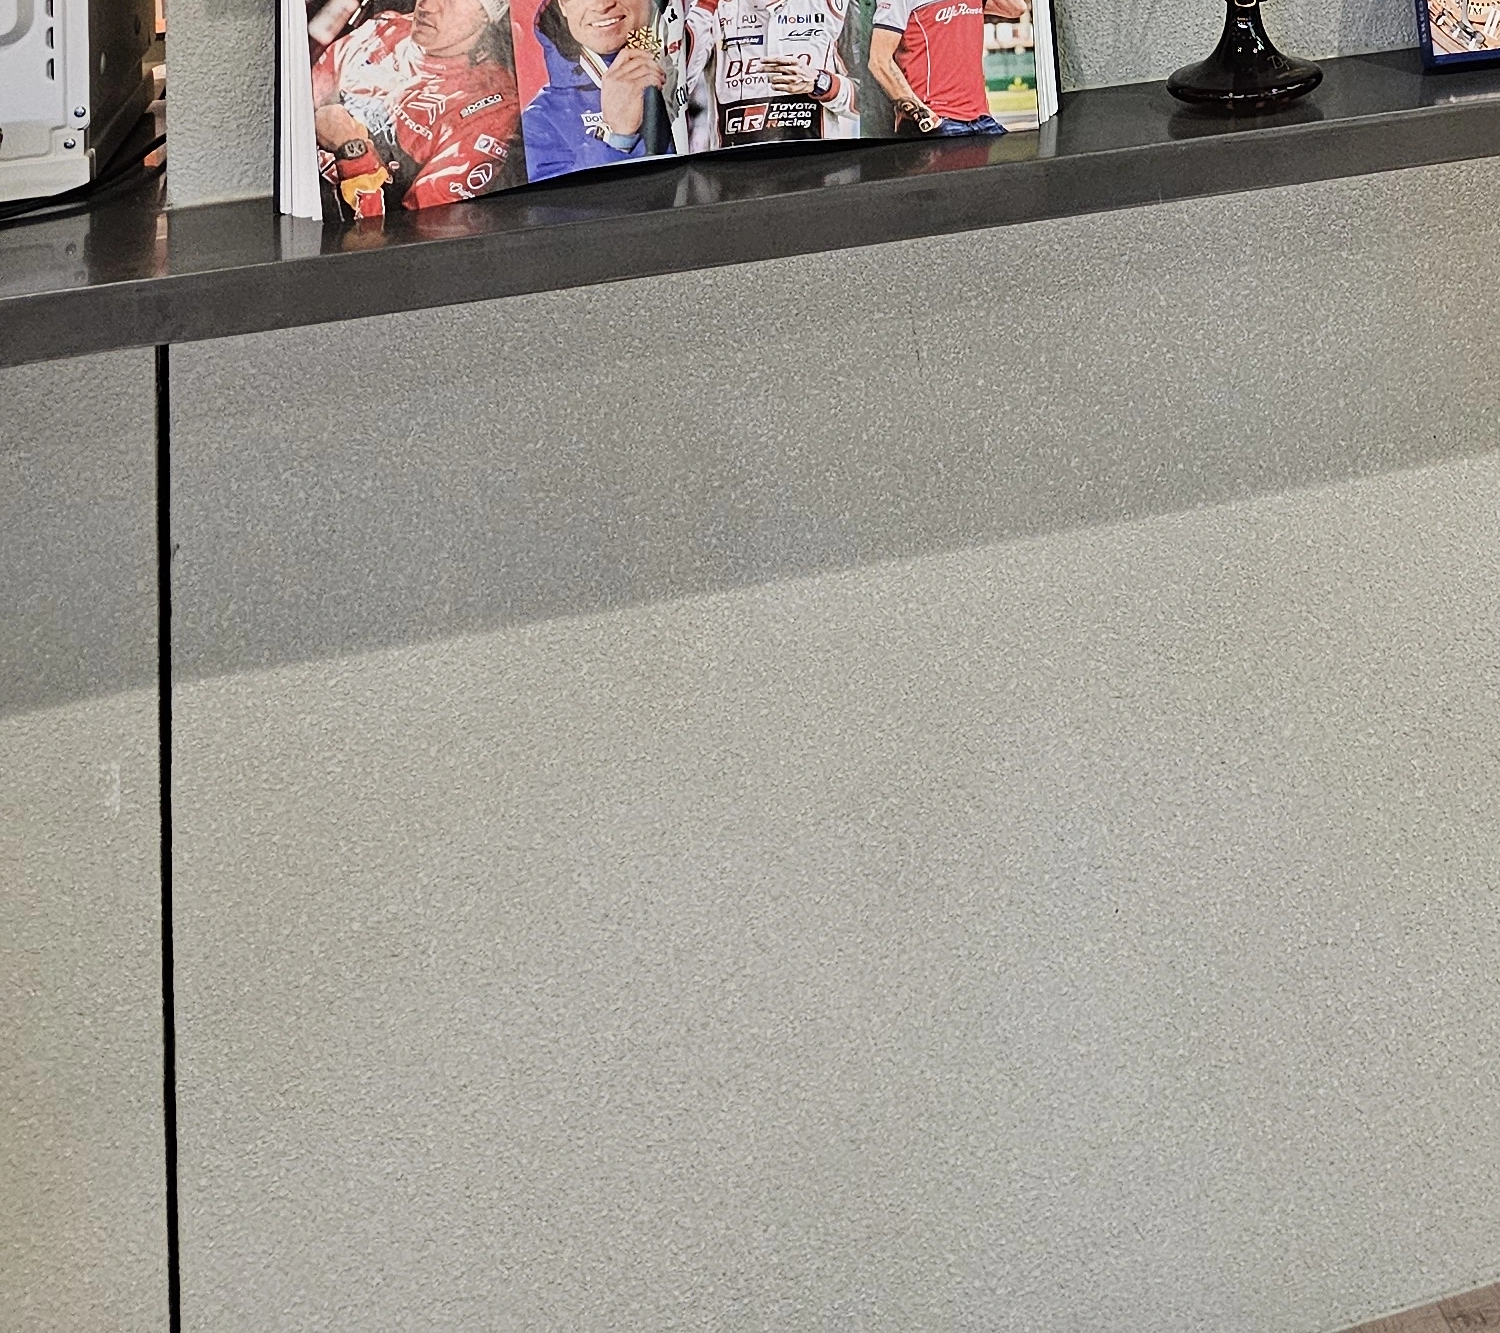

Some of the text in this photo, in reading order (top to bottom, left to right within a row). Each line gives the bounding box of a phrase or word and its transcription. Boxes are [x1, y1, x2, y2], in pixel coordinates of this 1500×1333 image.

[778, 14, 824, 24] Mobil 1
[725, 76, 766, 89] TOYOTA
[769, 103, 817, 112] TOYOTA
[768, 111, 812, 119] GAZOO
[727, 115, 764, 133] GR
[766, 119, 813, 129] Racing
